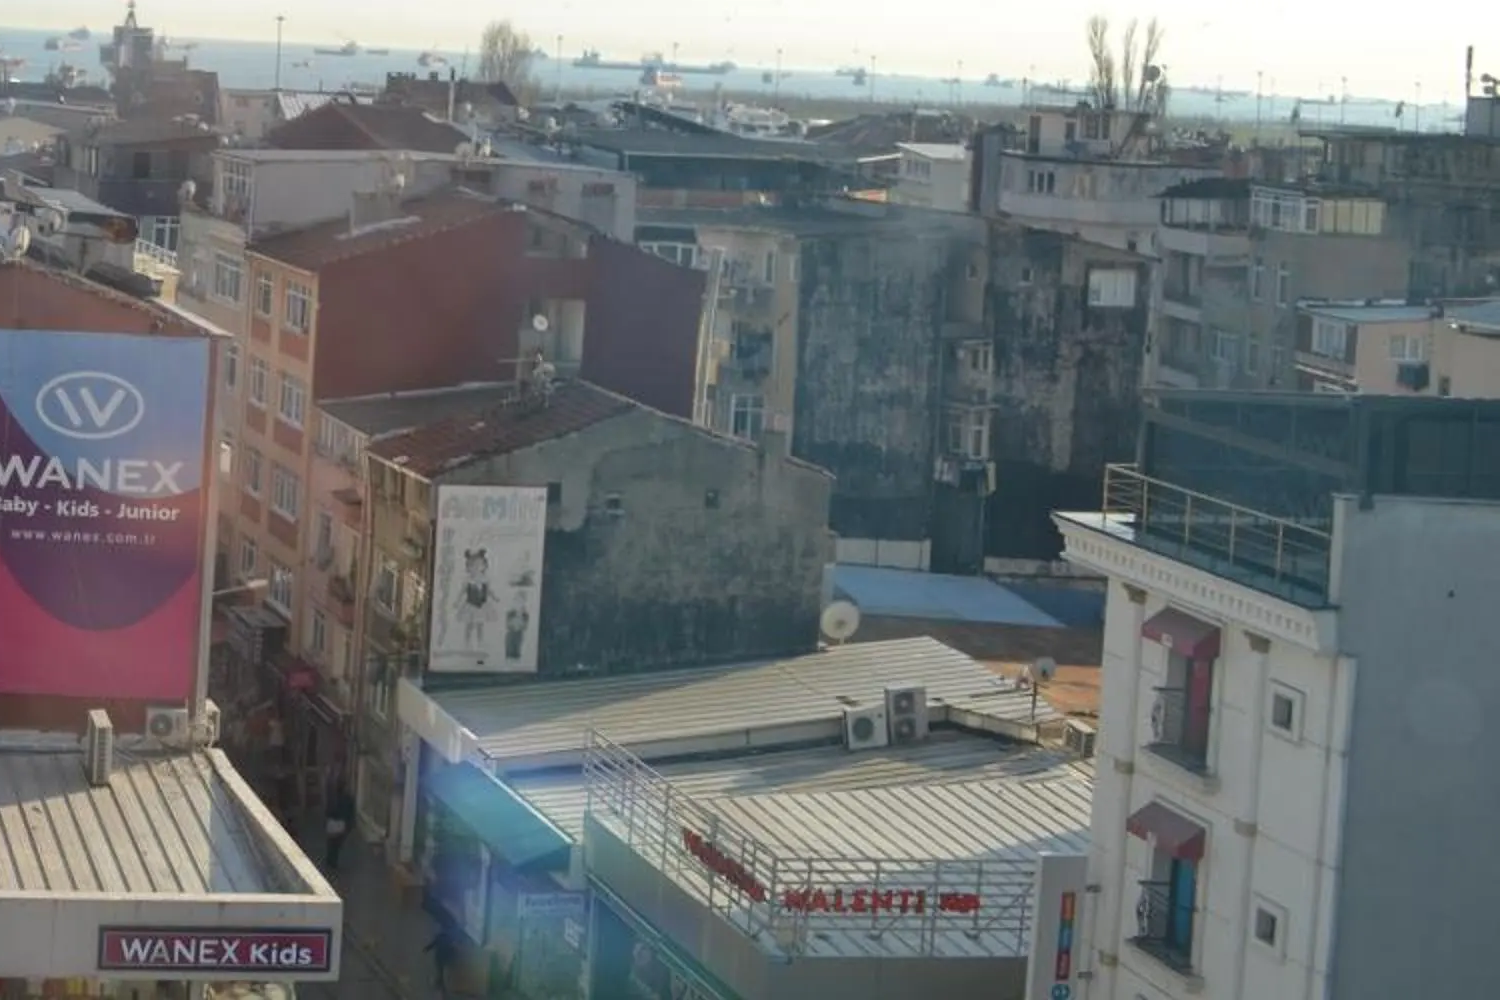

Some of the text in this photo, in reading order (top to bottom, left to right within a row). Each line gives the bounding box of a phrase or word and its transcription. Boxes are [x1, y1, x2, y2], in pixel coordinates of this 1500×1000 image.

[57, 499, 100, 518] Kids
[116, 503, 181, 521] Junior
[120, 937, 313, 966] WANEX Kids
